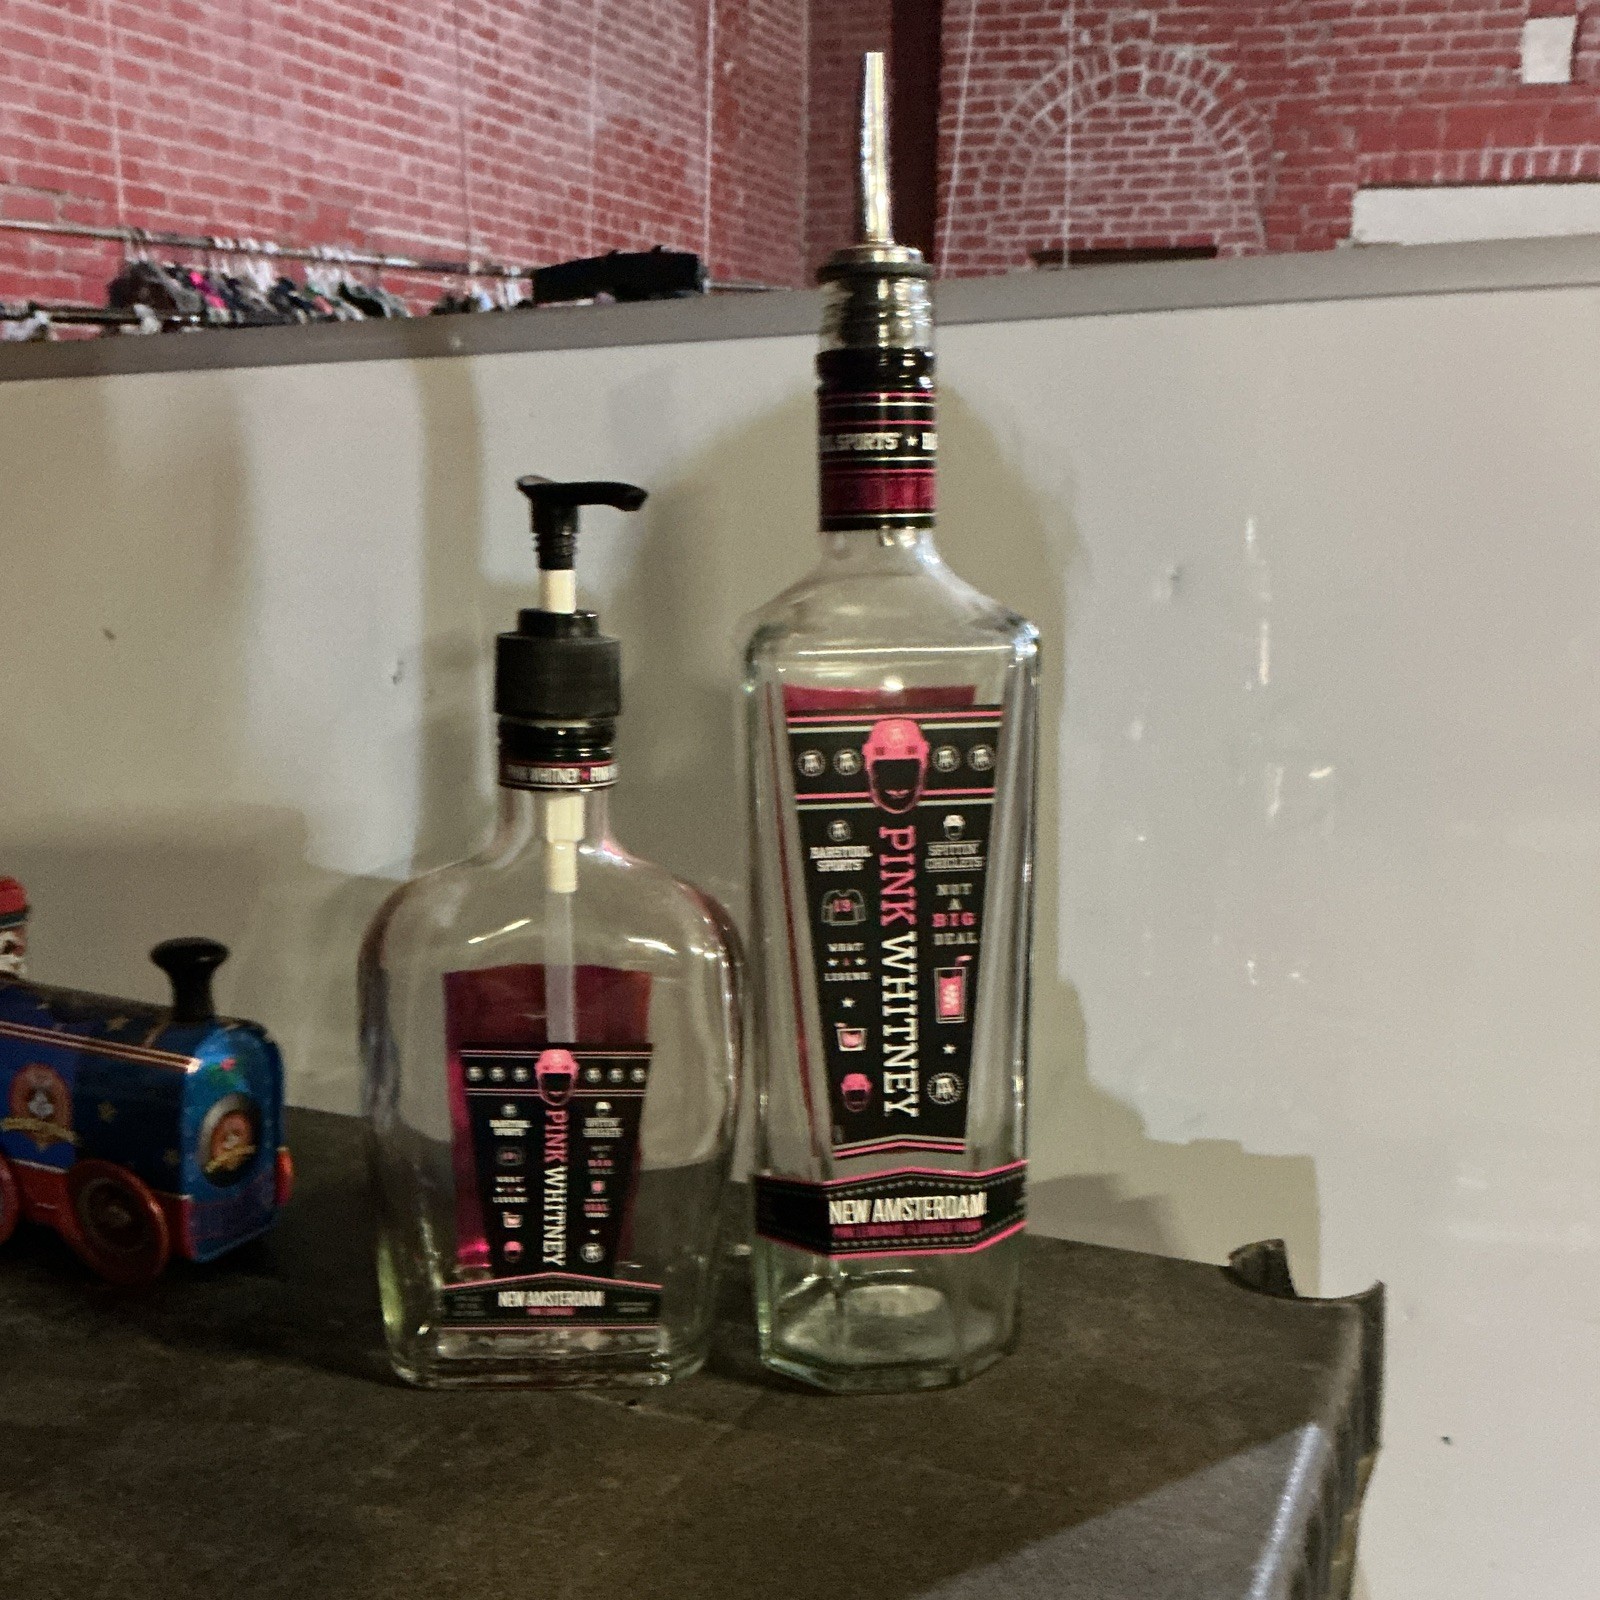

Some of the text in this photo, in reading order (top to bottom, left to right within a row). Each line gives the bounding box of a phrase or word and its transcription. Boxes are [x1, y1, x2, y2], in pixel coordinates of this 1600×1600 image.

[931, 911, 977, 928] BIG
[879, 825, 920, 1118] PINK WHITNEY
[542, 1109, 570, 1267] PINK WHITNEY
[828, 1191, 988, 1225] NEW AMSTERDAM
[497, 1291, 525, 1308] NEW
[526, 1291, 606, 1307] AMSTERDAM
